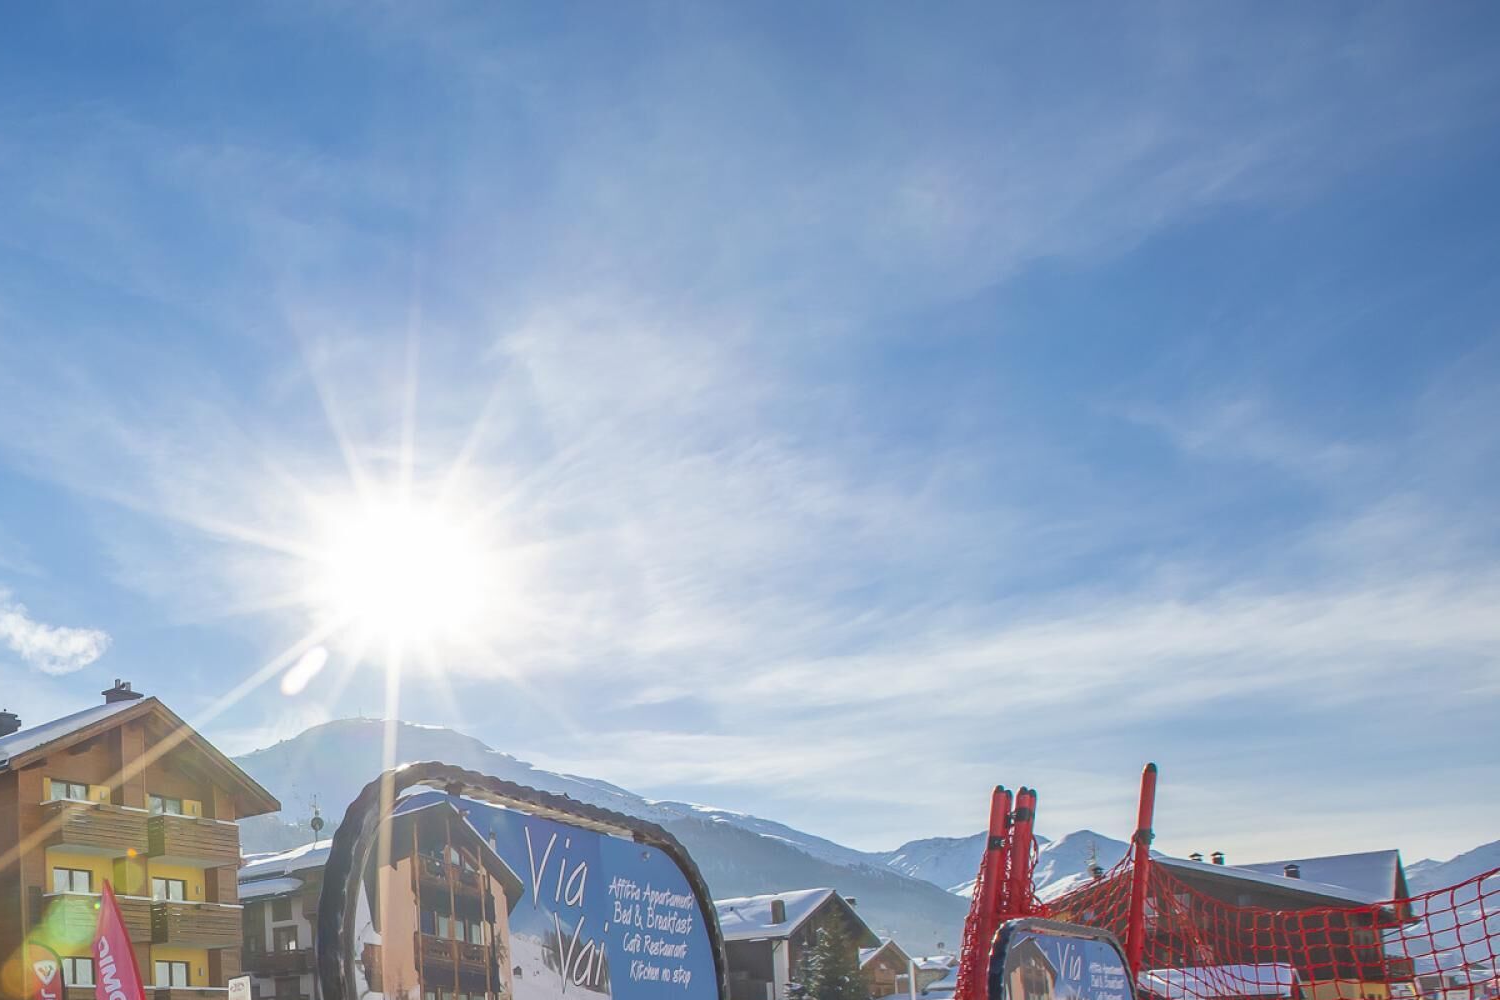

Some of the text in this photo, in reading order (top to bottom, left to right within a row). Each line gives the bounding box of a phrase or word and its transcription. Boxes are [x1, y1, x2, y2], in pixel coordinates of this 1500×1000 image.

[524, 826, 588, 909] Via
[613, 901, 693, 935] Bed & Breakfast
[553, 911, 609, 994] Vai
[1057, 942, 1081, 981] Via
[629, 959, 691, 990] Kitchen no stop
